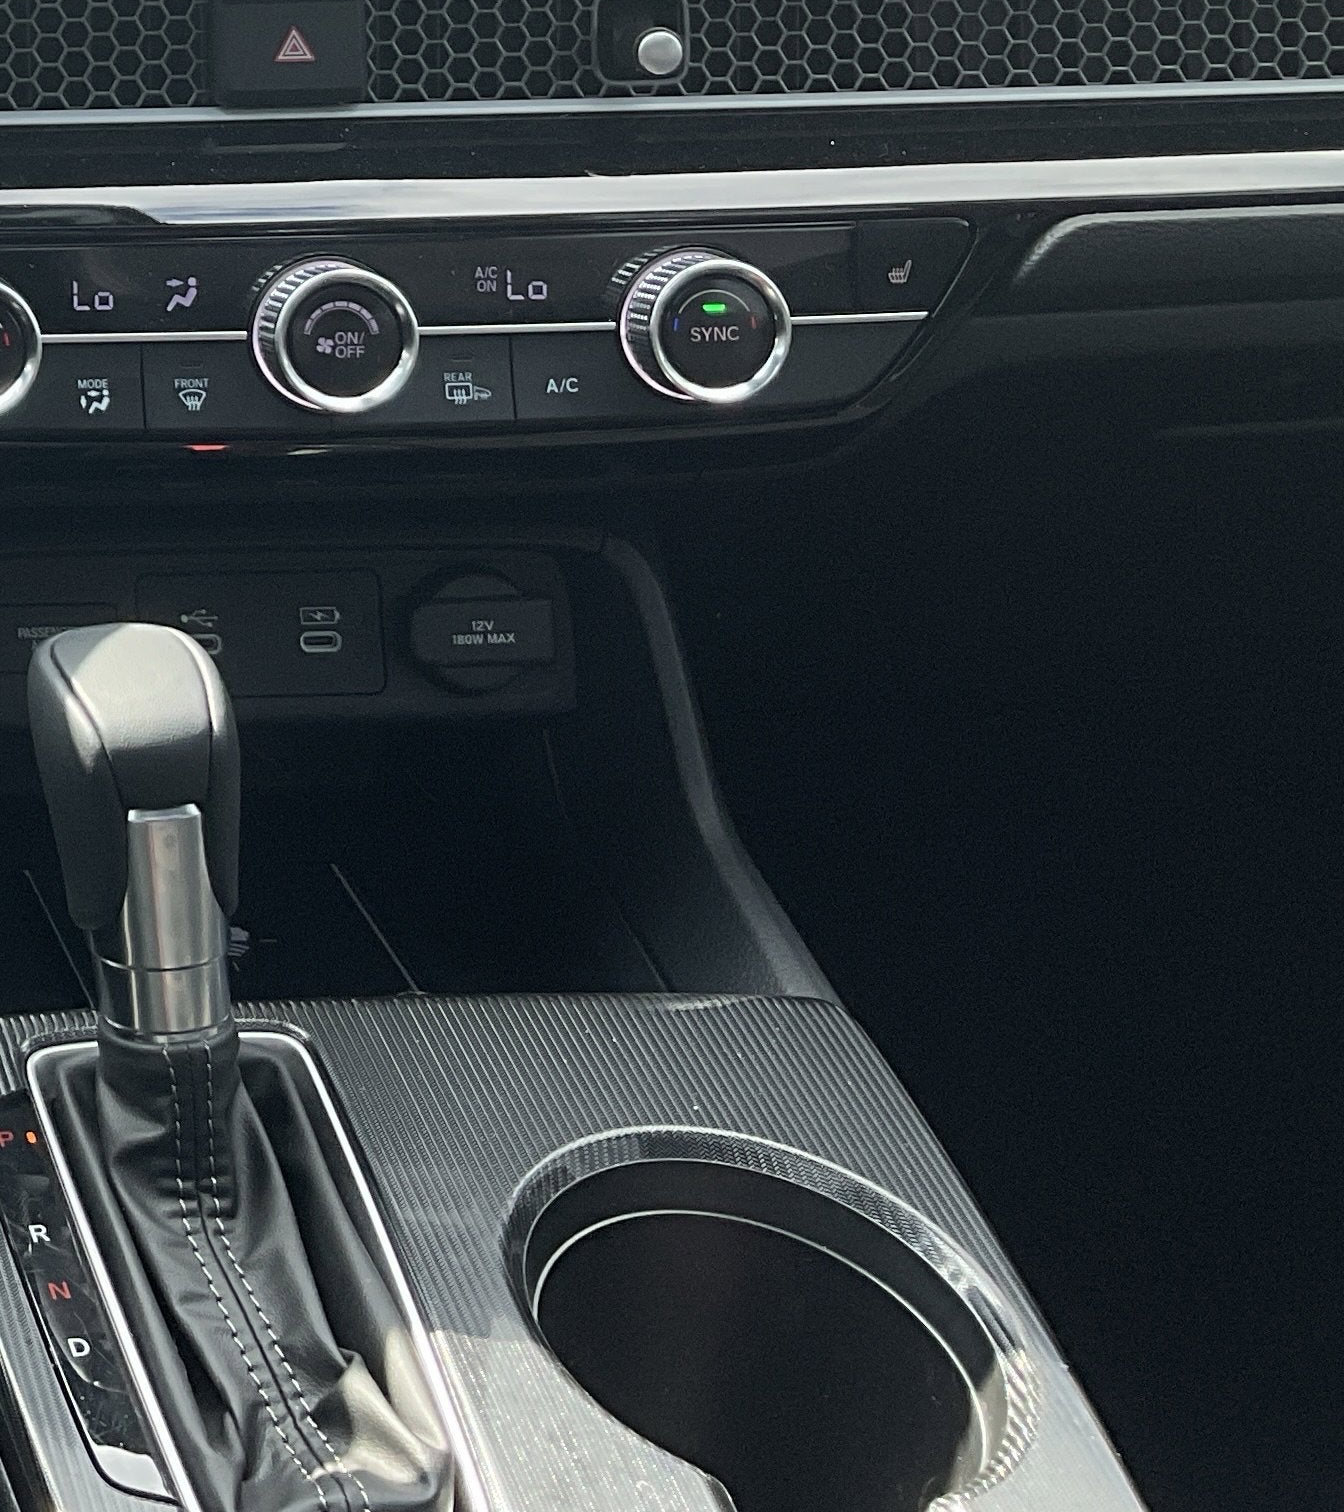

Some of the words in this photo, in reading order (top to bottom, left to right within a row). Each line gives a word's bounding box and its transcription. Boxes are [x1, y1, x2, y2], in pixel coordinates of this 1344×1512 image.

[474, 266, 498, 279] A/C
[476, 279, 497, 293] ON
[506, 269, 548, 300] Lo
[73, 280, 114, 311] Lo
[334, 331, 365, 345] ON/
[690, 326, 740, 342] SYNC
[334, 345, 365, 359] OFF
[77, 378, 108, 389] MODE
[174, 378, 209, 389] FRONT
[443, 372, 473, 382] REAR
[546, 377, 579, 393] A/C
[471, 620, 494, 631] 12V
[452, 634, 484, 645] 180W
[487, 633, 516, 644] MAX
[28, 1224, 51, 1243] R
[48, 1280, 72, 1300] N
[67, 1337, 91, 1358] D
